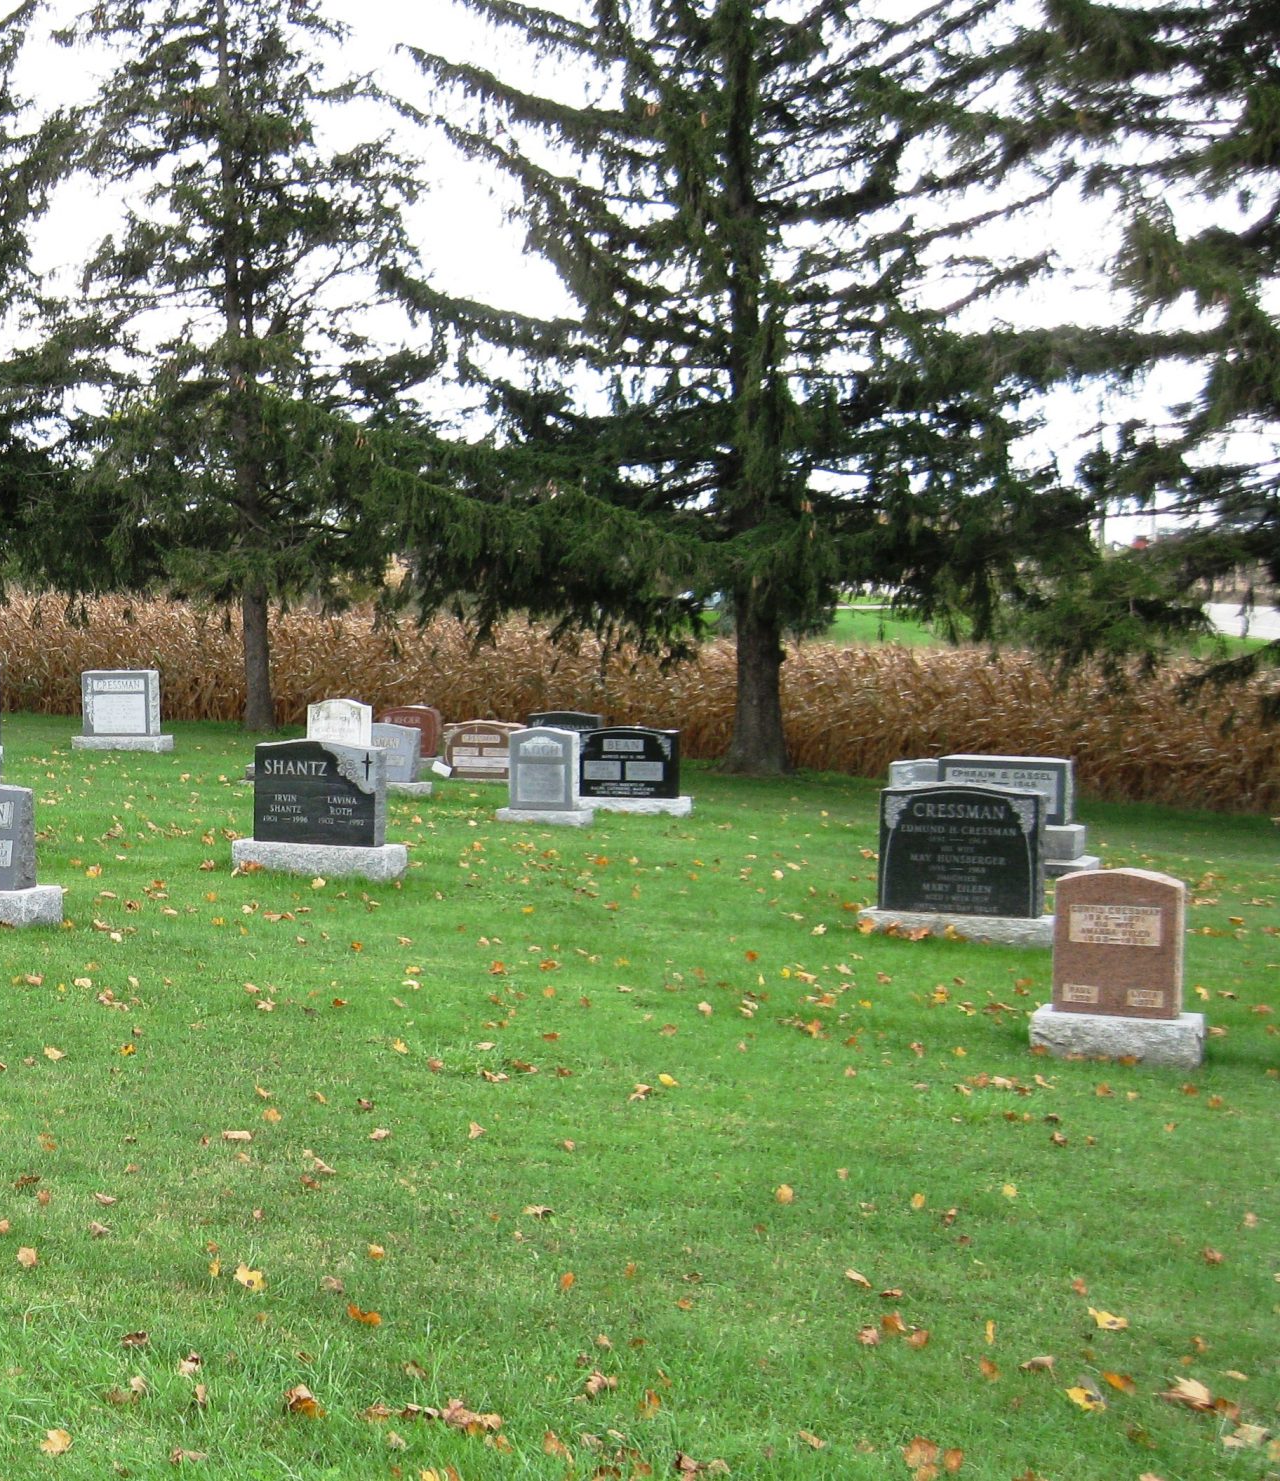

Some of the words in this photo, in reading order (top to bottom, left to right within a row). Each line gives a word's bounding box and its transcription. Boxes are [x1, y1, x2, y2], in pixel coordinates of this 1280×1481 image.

[96, 680, 140, 690] CRESSMAN
[523, 745, 559, 755] KOCH
[608, 741, 640, 750] BEAN
[264, 759, 328, 776] SHANTZ
[952, 769, 996, 778] EPHRAIM
[1013, 771, 1053, 780] CASSEL
[274, 794, 297, 802] IRVIN
[327, 796, 357, 805] LAVINA
[270, 804, 302, 814] SHANTZ
[330, 806, 353, 816] ROTH
[913, 802, 1006, 820] CRESSMAN
[901, 824, 945, 834] EDMUND
[961, 826, 1017, 836] CRESSMAN
[937, 854, 1007, 865] HUNSBERGER
[922, 883, 950, 891] MARY
[956, 884, 992, 893] EILEEN
[1108, 906, 1160, 915] CRESSMAN
